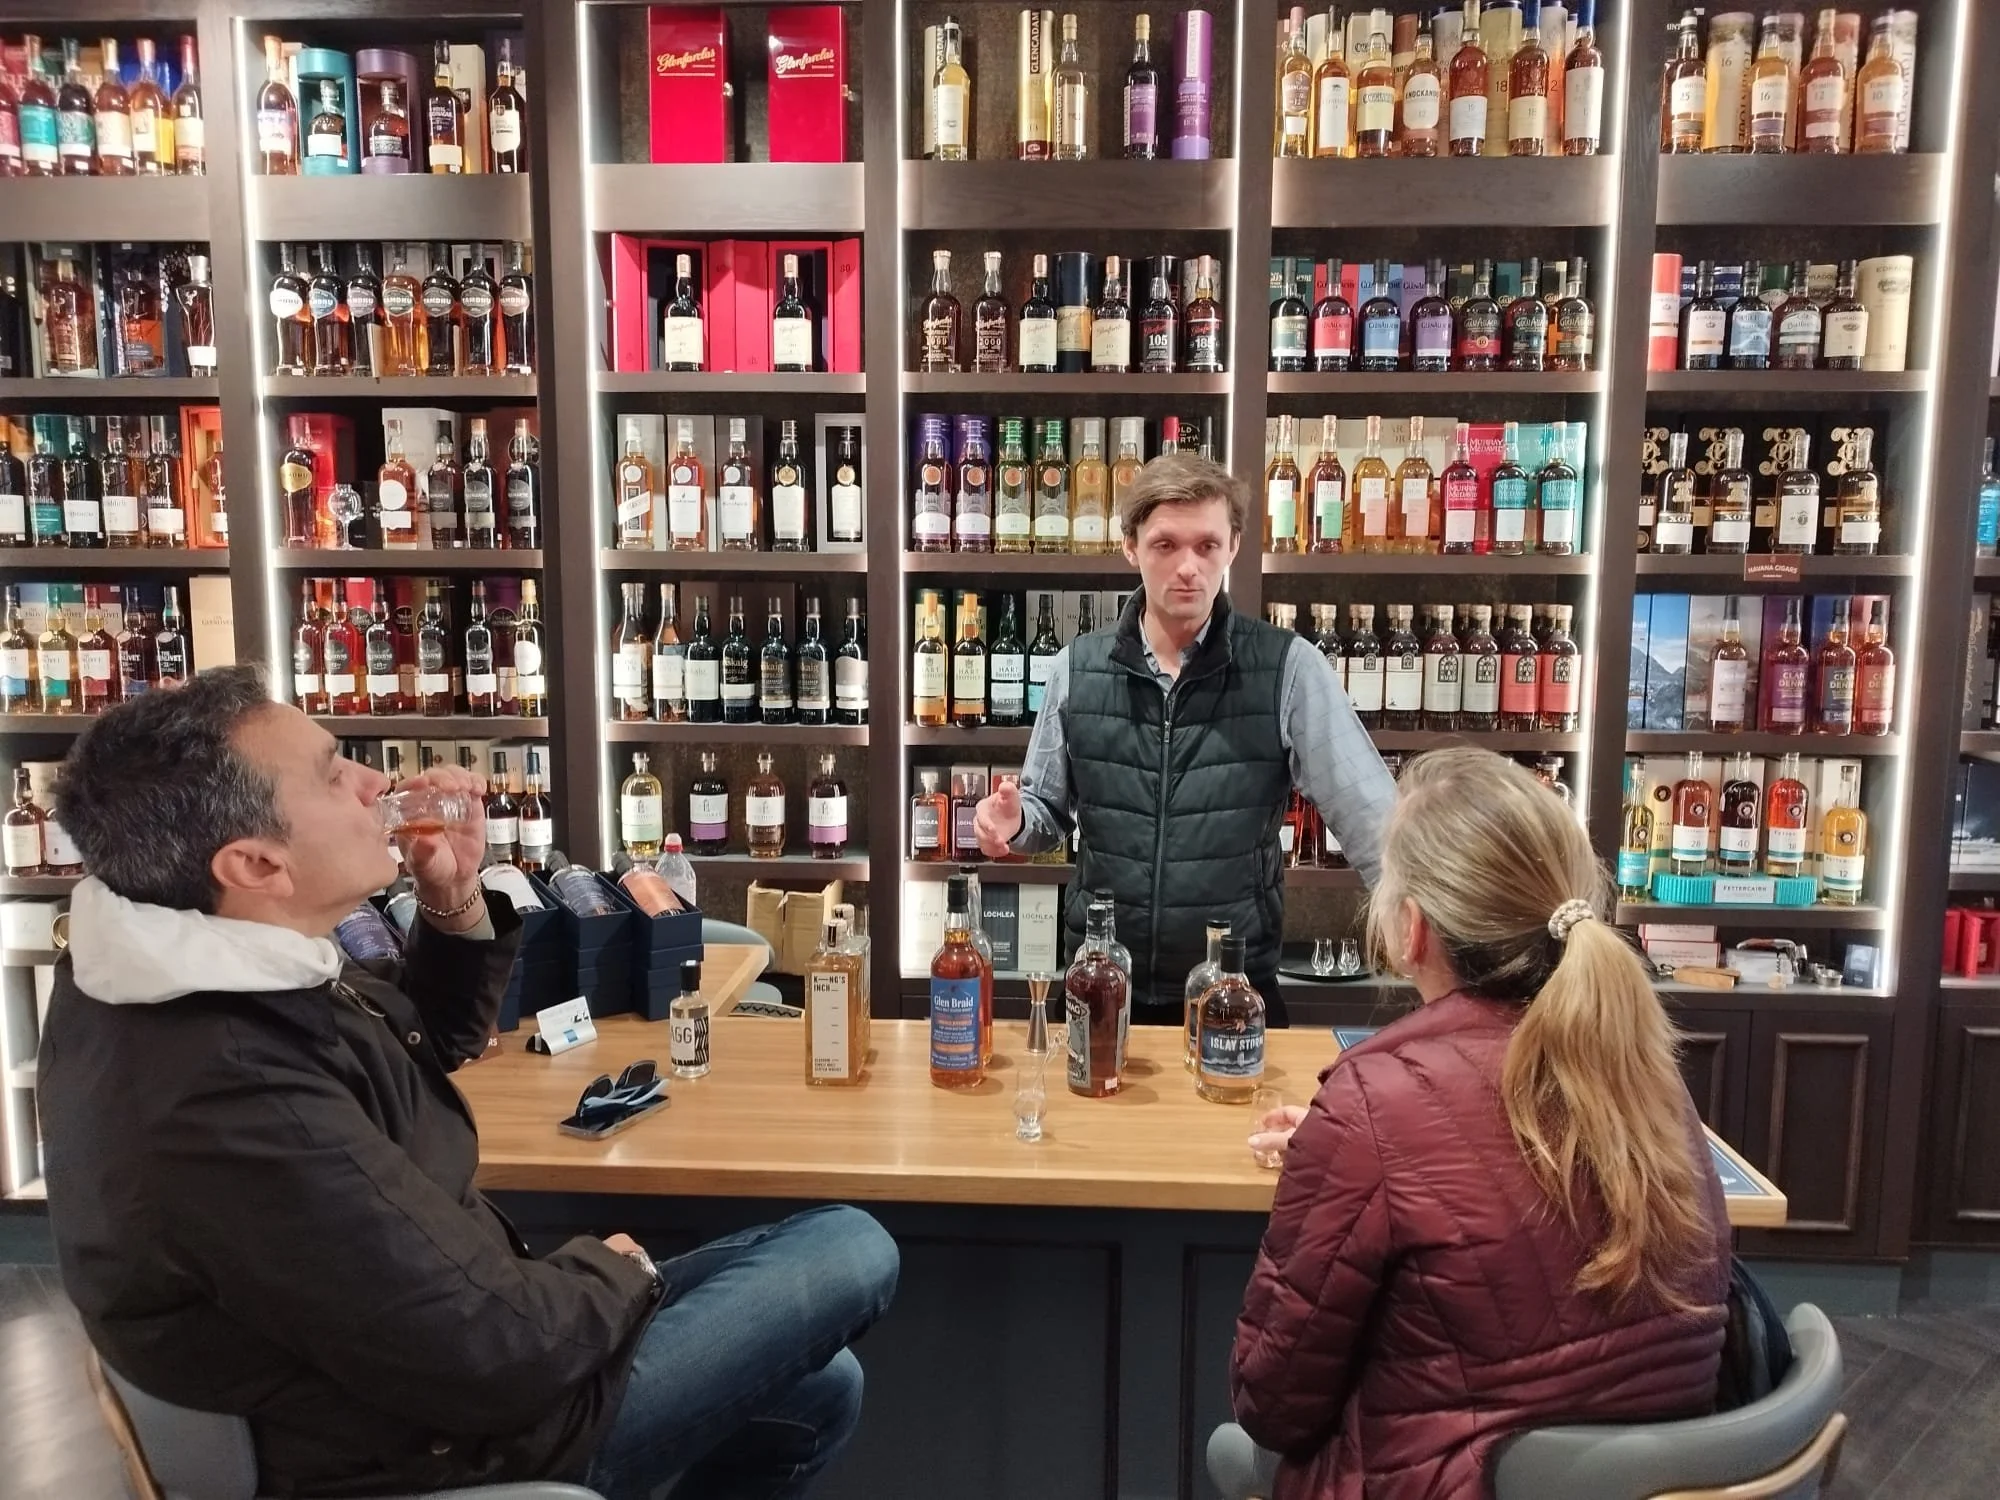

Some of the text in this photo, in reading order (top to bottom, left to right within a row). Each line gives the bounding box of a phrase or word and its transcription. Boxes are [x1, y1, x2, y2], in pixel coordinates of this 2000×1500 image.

[1031, 11, 1040, 73] GLENCADAM
[657, 47, 715, 72] Glenfarclas
[776, 48, 834, 74] Glenfarclas
[1496, 81, 1508, 92] 18
[1149, 335, 1168, 345] 105
[1470, 438, 1503, 446] MURRAY
[1748, 564, 1798, 574] HAVANA CIGARS
[1783, 672, 1804, 680] CLAN
[1737, 840, 1750, 848] 40
[1839, 870, 1849, 878] 12
[813, 984, 831, 992] INCH
[934, 995, 951, 1008] Glen
[951, 995, 974, 1010] Braid
[1211, 1036, 1237, 1052] ISLAY
